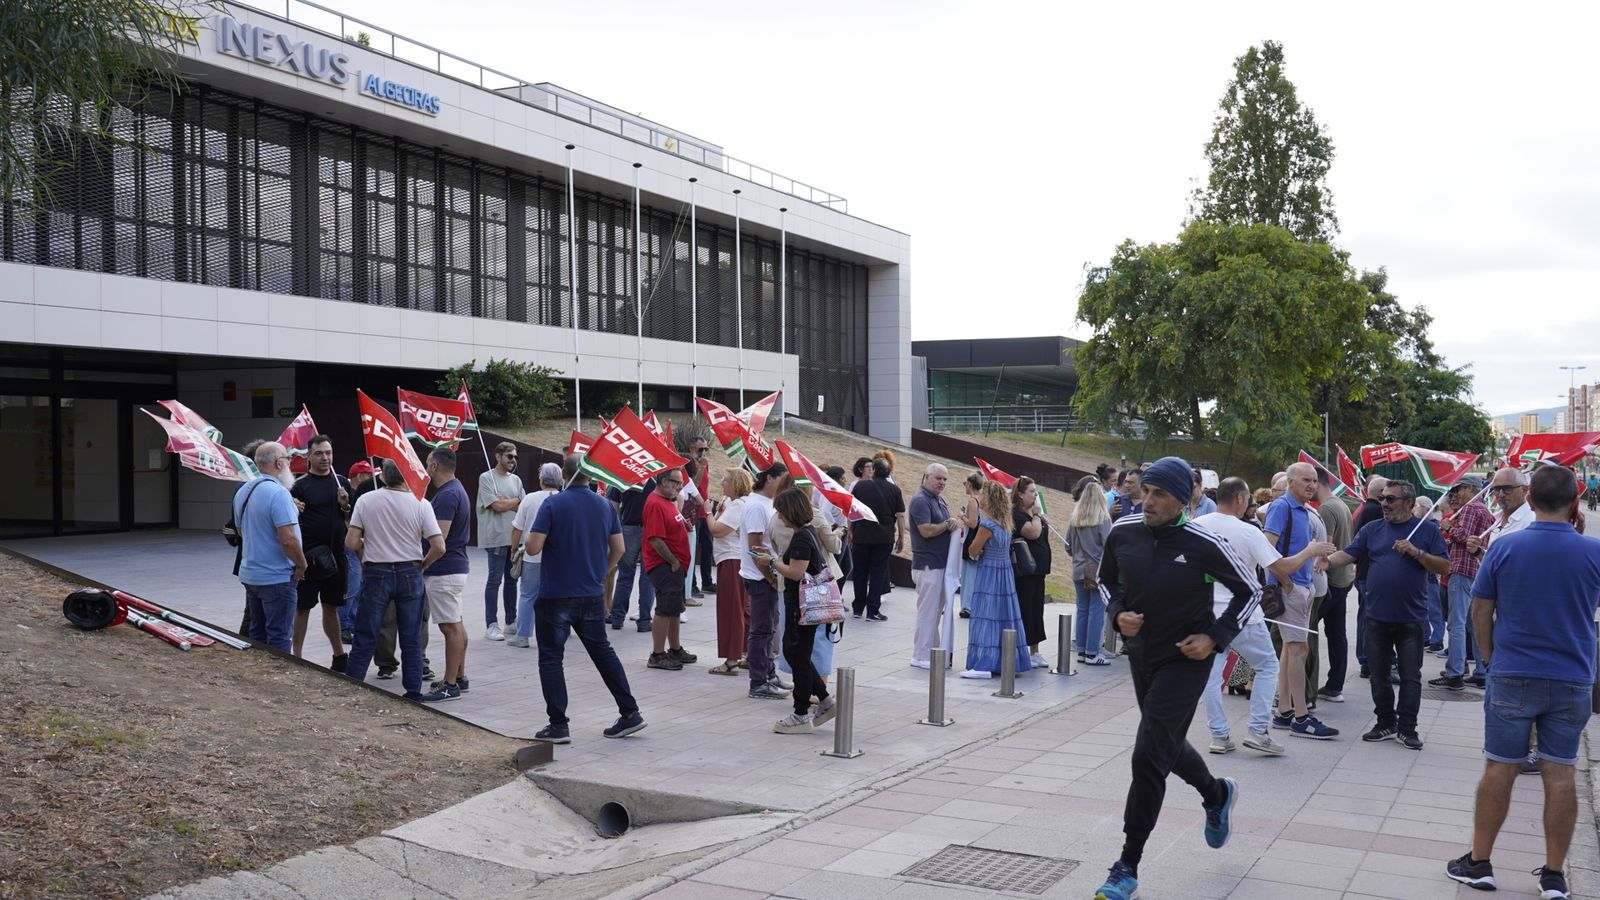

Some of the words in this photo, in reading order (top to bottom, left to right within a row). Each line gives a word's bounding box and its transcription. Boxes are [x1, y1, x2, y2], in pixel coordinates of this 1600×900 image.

[222, 16, 350, 85] NEXUS
[364, 74, 442, 115] ALGECIRAS
[620, 458, 650, 479] Cádiz
